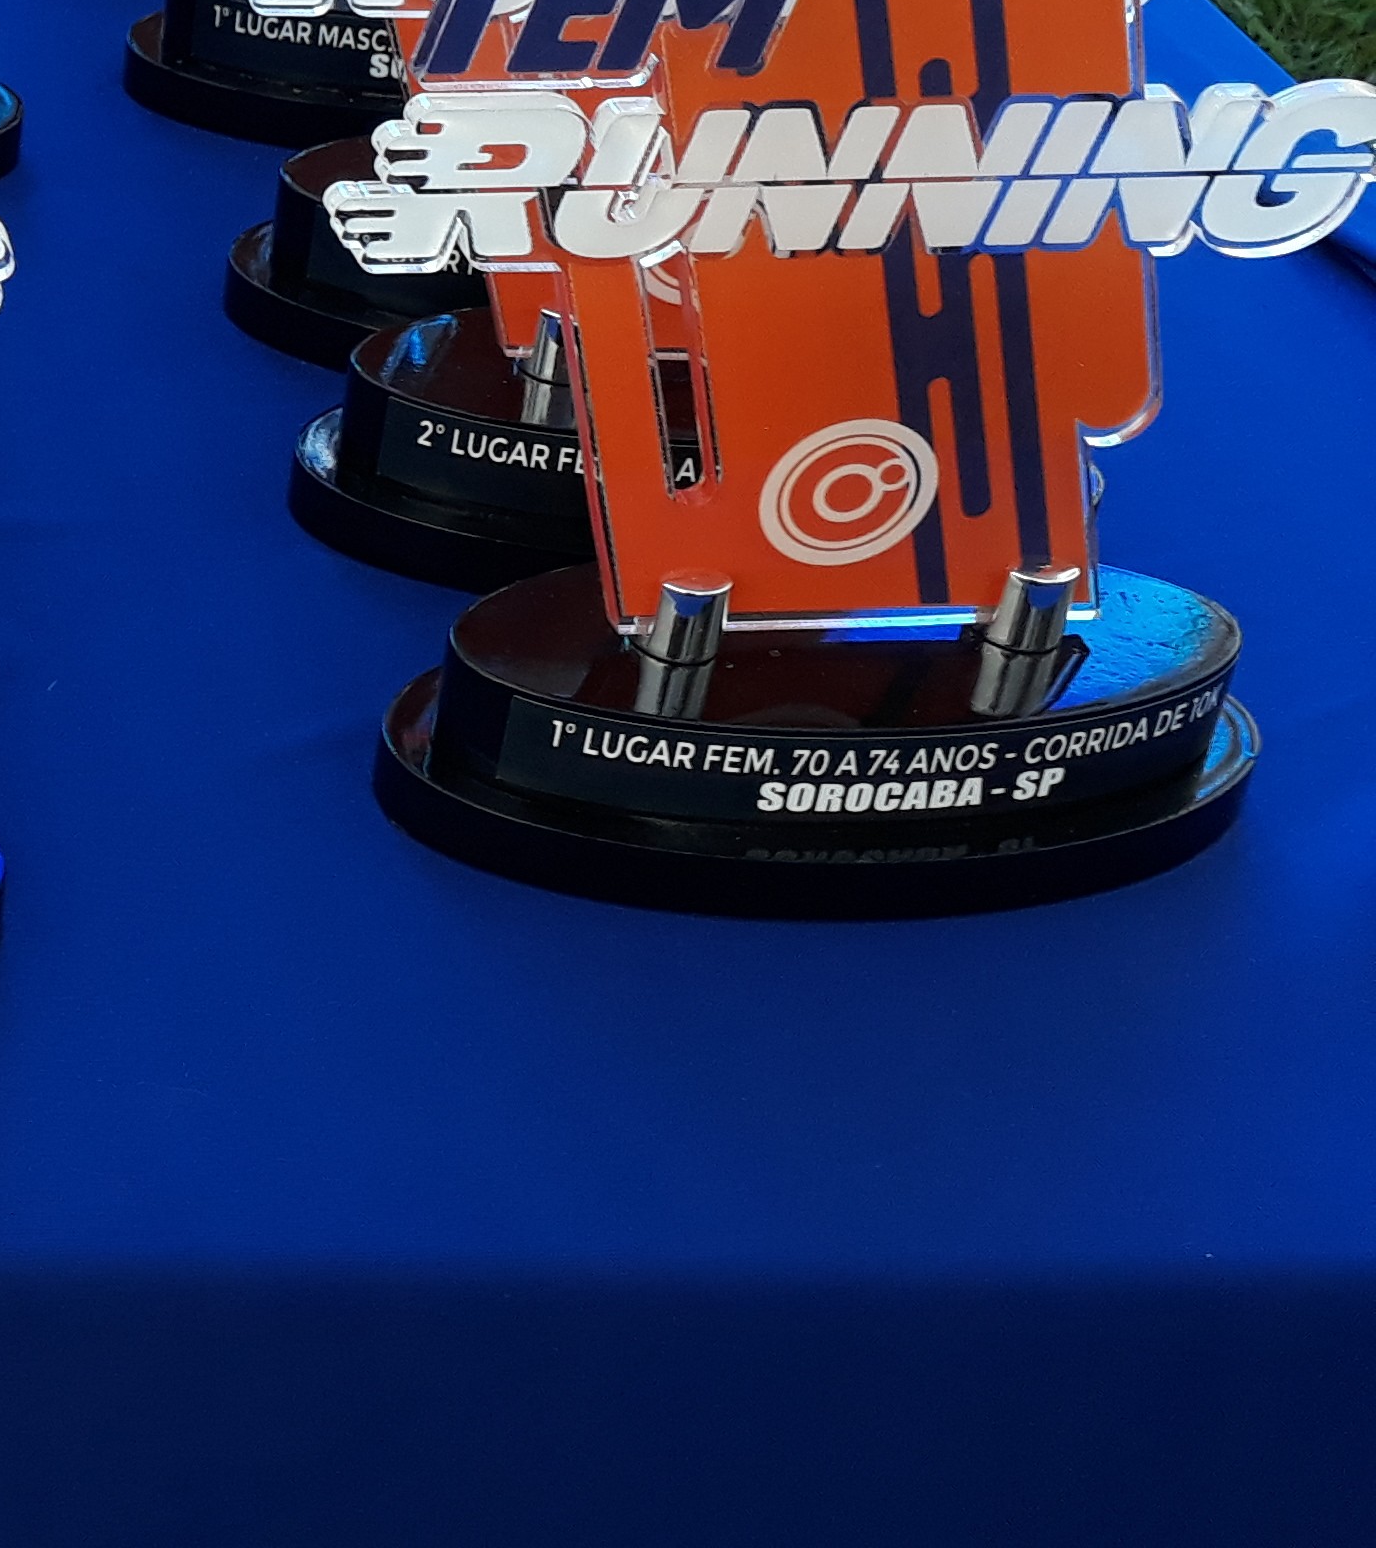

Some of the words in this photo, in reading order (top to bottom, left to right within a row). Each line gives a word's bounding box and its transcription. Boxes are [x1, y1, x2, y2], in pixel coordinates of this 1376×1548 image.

[234, 10, 312, 45] LUGAR
[326, 86, 1376, 267] RUNNING
[451, 428, 550, 471] LUGAR
[582, 727, 696, 770] LUGAR
[703, 745, 781, 775] FEM.
[791, 749, 830, 777] 70
[834, 750, 859, 777] A
[867, 749, 900, 777] 74
[905, 742, 999, 775] ANOS
[1024, 717, 1148, 765] CORRIDA
[1153, 703, 1187, 738] DE
[1189, 683, 1224, 723] 10K
[756, 777, 984, 813] SOROCABA
[1012, 767, 1066, 801] SP
